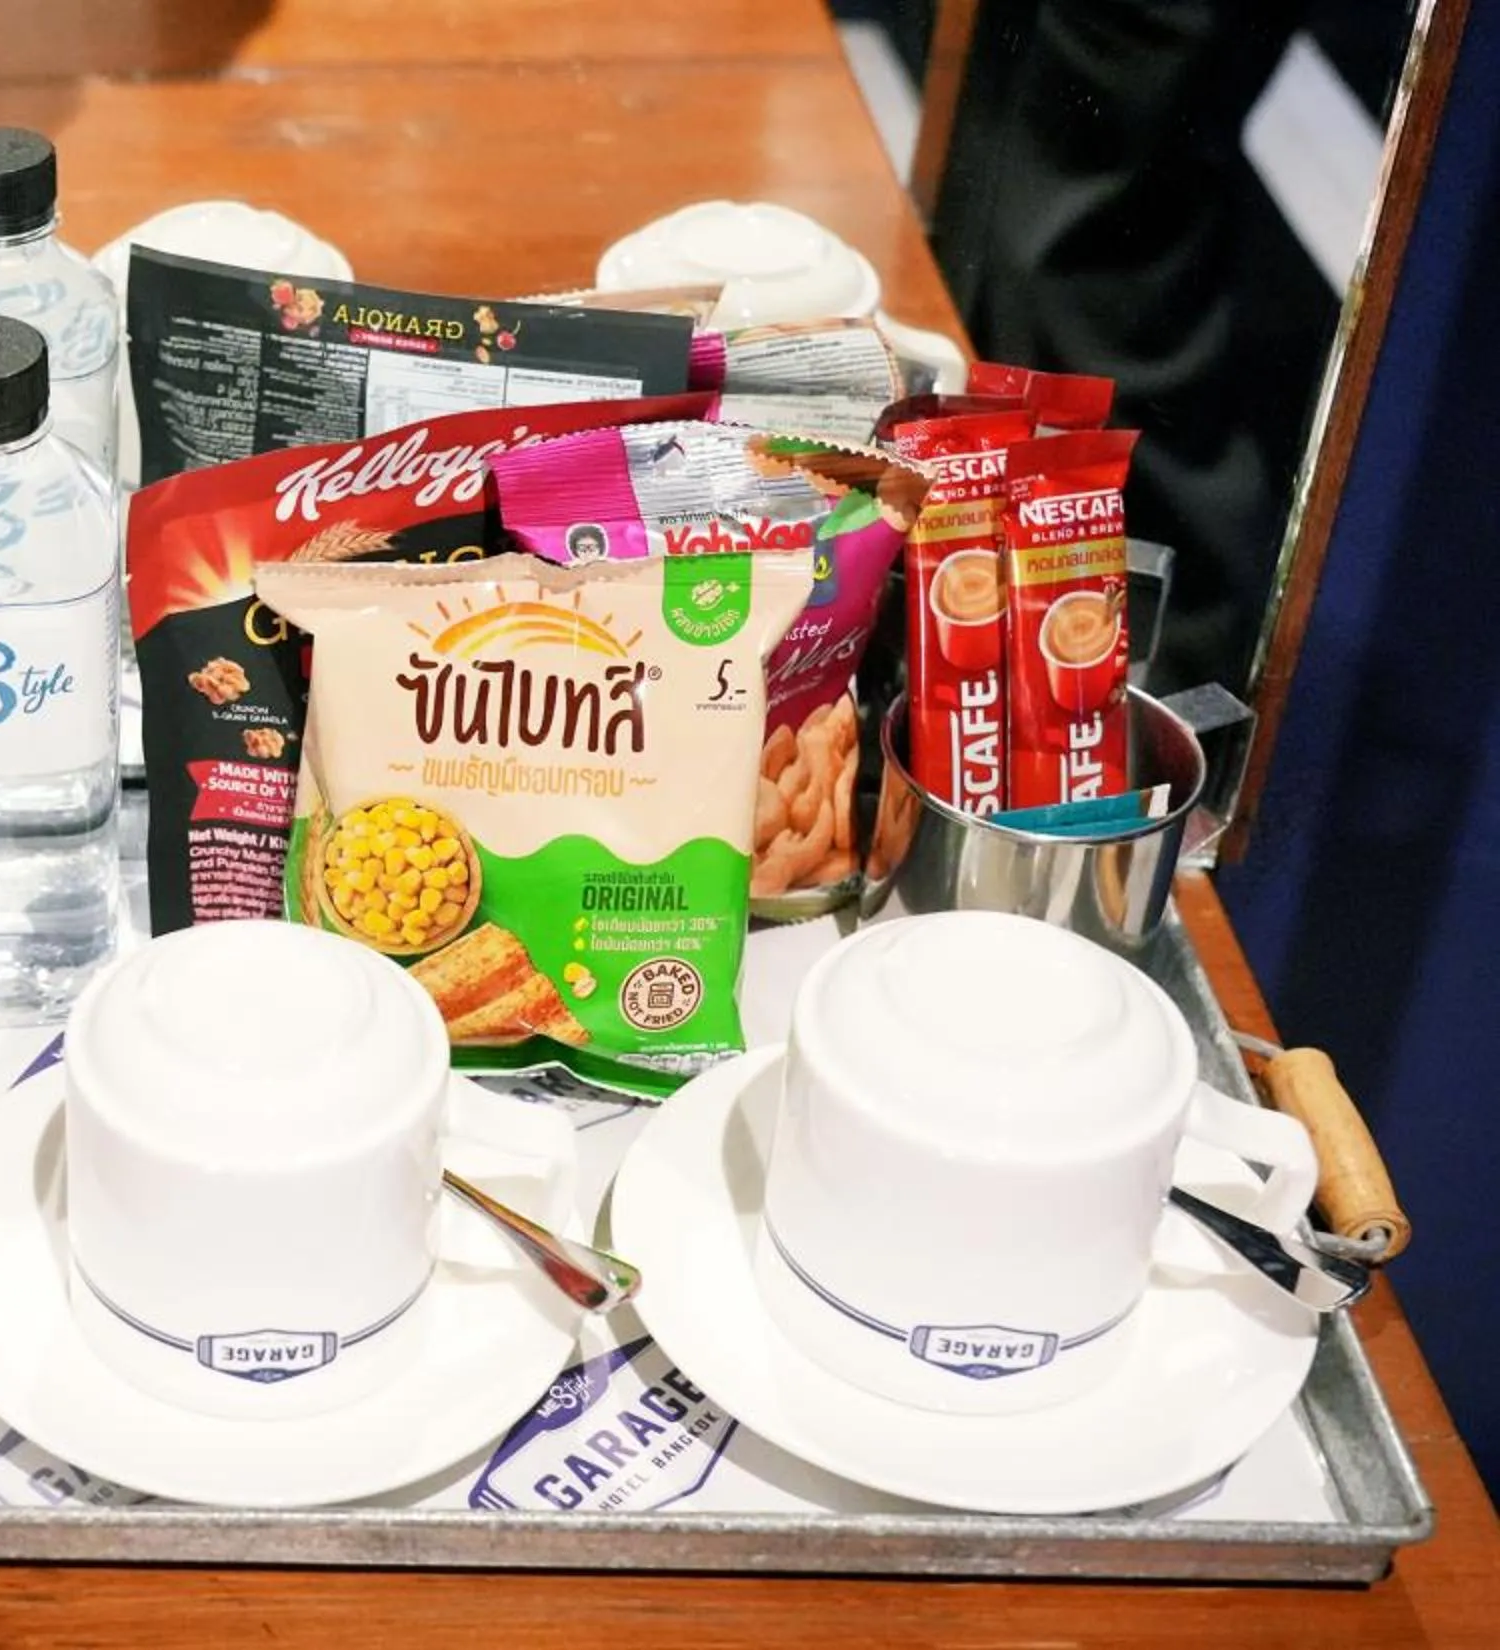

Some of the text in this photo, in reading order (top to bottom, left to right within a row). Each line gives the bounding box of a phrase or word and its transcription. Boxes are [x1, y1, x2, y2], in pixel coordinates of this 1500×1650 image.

[930, 449, 1008, 484] ESCAF
[1031, 528, 1074, 543] BLEND
[581, 885, 689, 911] ORIGINAL
[642, 964, 695, 995] BAKED
[627, 991, 684, 1024] NOT FRIED
[221, 1343, 315, 1361] GARAGE
[937, 1337, 1035, 1359] GARAGE
[534, 1367, 707, 1510] GARAGE
[598, 1411, 720, 1512] HOTEL BANGKOK
